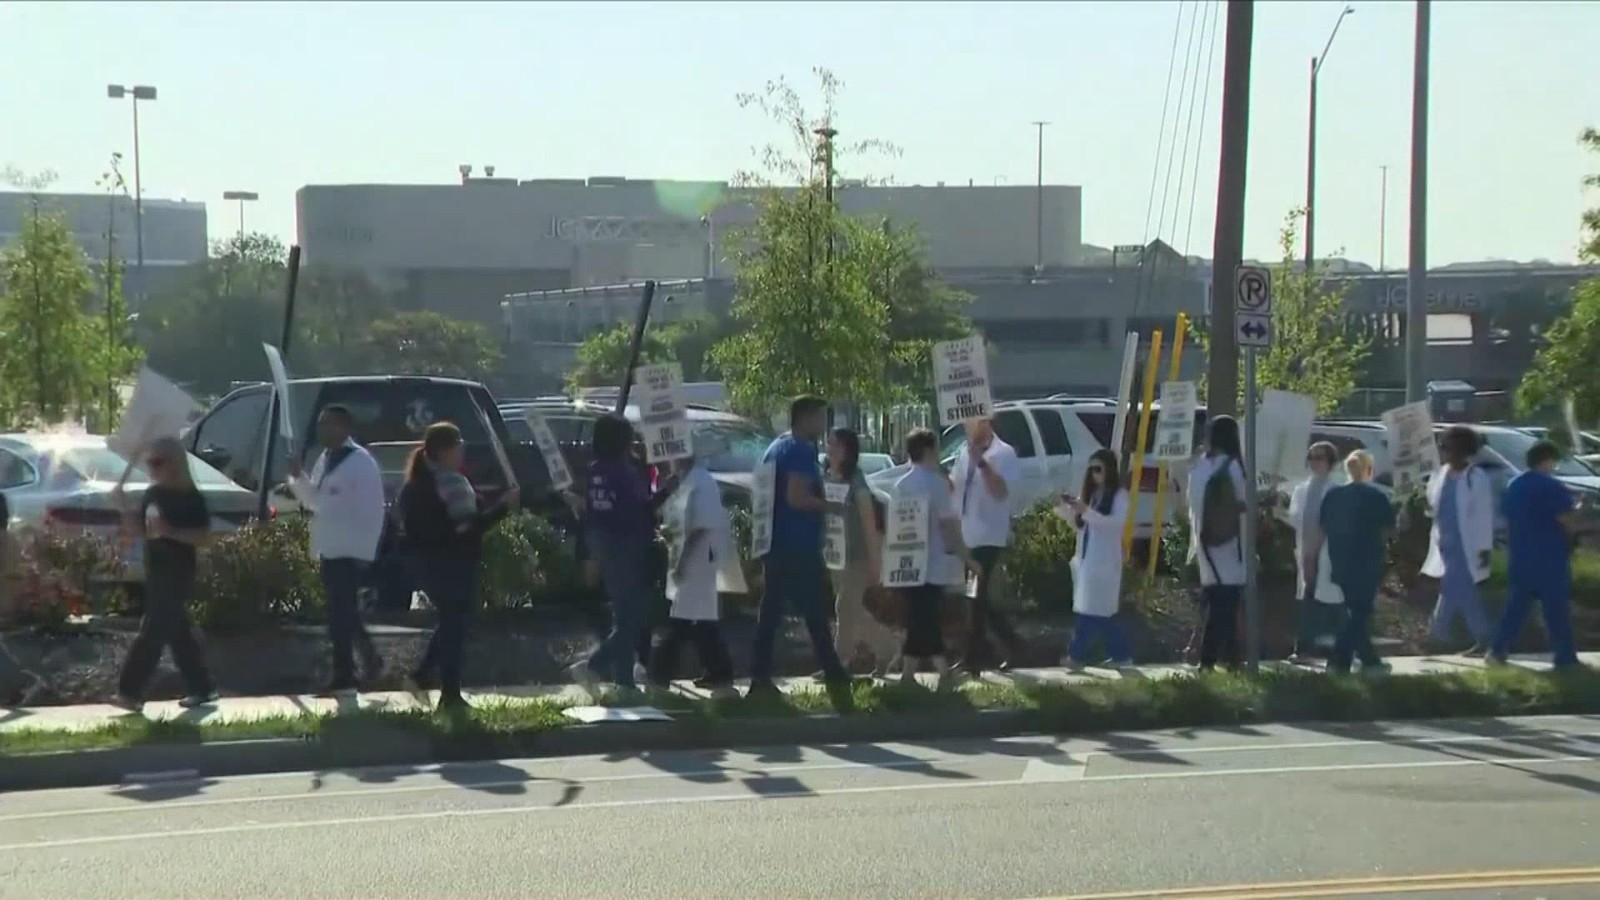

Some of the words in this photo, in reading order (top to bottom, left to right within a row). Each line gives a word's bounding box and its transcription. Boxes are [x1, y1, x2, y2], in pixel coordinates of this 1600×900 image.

[956, 391, 973, 405] ON
[947, 402, 985, 420] STRIKE
[652, 439, 688, 457] STRIKE
[889, 568, 920, 583] STRIKE
